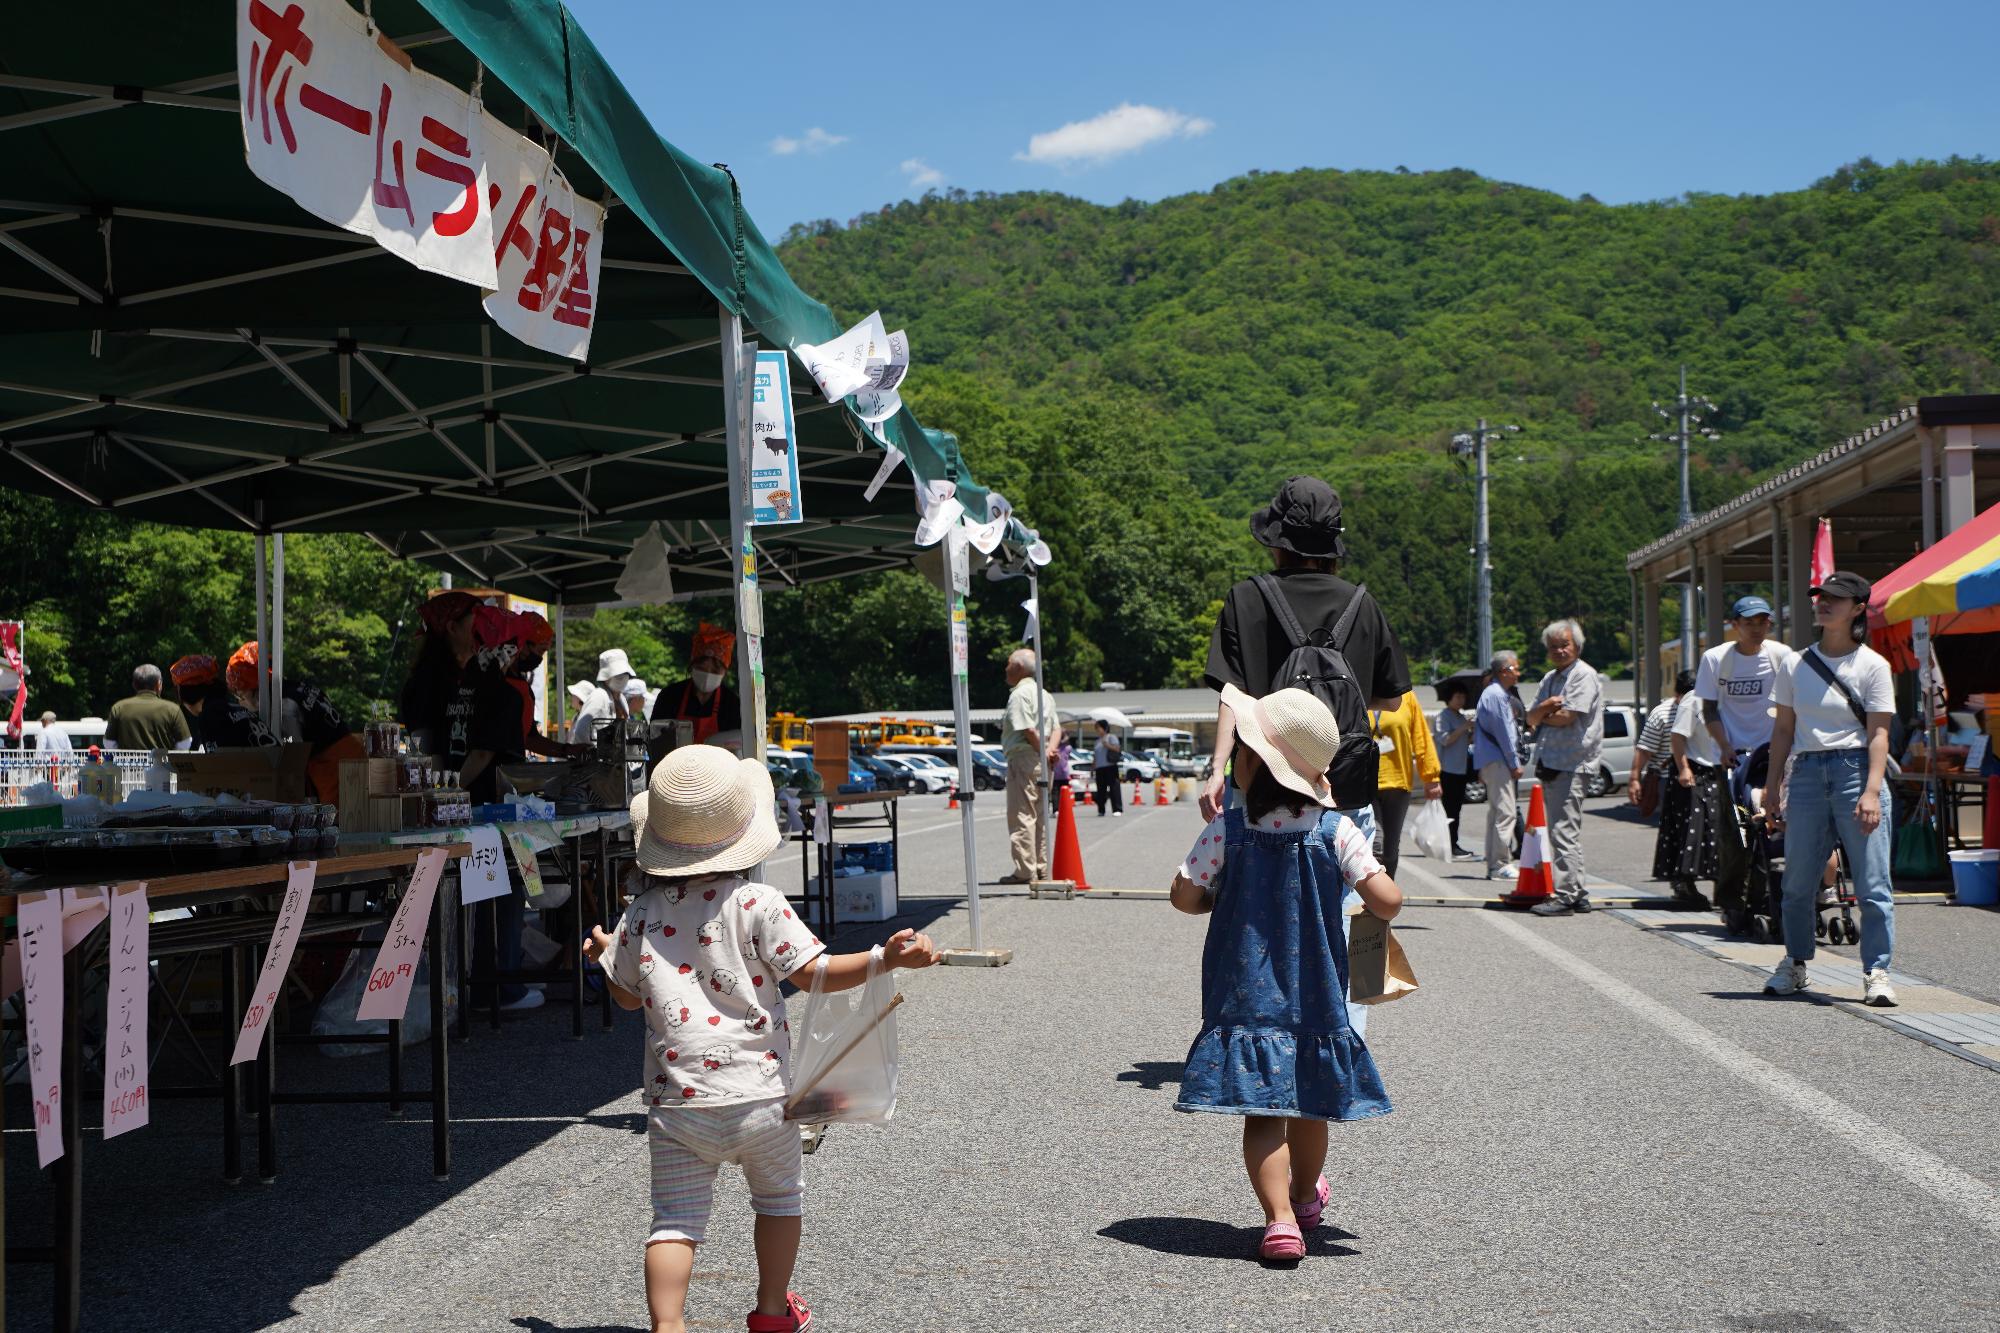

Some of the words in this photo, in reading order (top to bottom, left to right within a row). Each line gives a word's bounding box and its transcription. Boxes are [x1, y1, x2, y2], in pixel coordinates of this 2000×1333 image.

[755, 422, 776, 432] 肉が
[1728, 681, 1761, 694] 1969
[465, 846, 498, 870] ハチミツ
[265, 888, 304, 970] 割子そば
[368, 963, 412, 993] 600円
[110, 1085, 146, 1125] 450円
